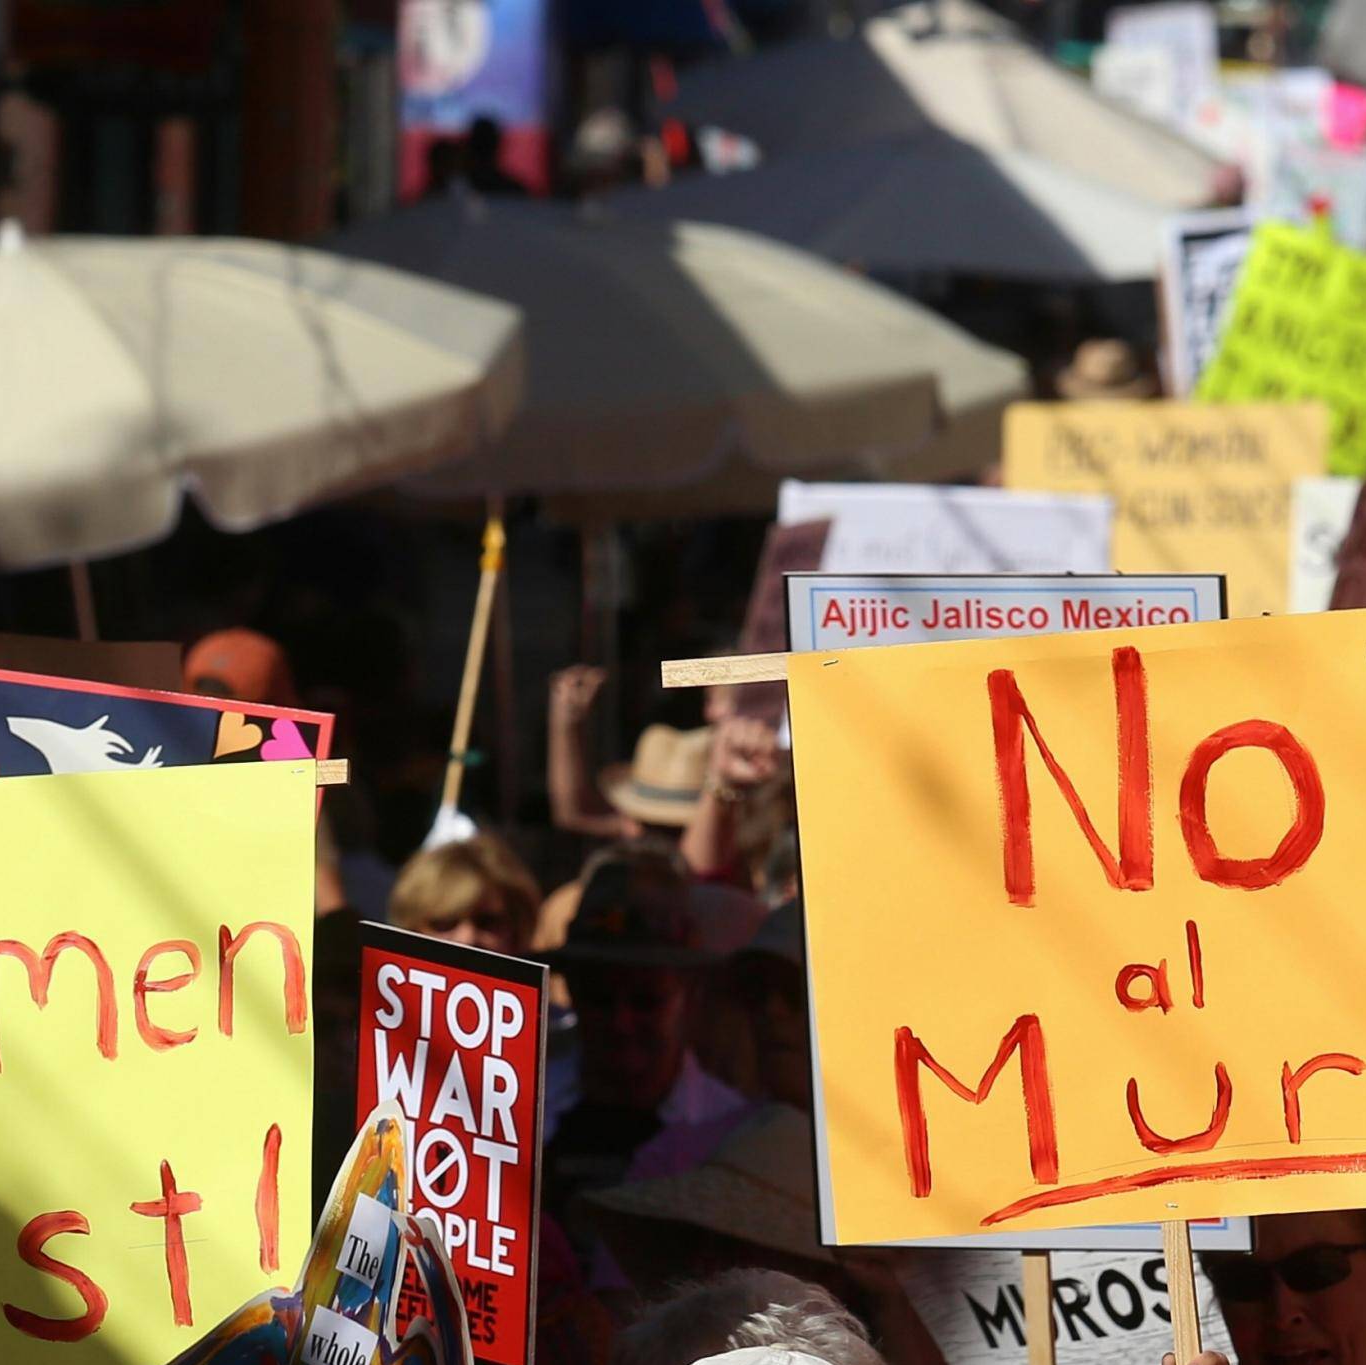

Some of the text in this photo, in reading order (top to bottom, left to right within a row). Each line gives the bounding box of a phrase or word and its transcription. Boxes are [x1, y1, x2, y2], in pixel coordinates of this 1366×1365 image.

[822, 598, 1190, 637] Ajijic Jalisco Mexico
[375, 963, 524, 1056] STOP
[1115, 920, 1205, 1014] al
[374, 1029, 519, 1144] WAR
[345, 1234, 380, 1280] The
